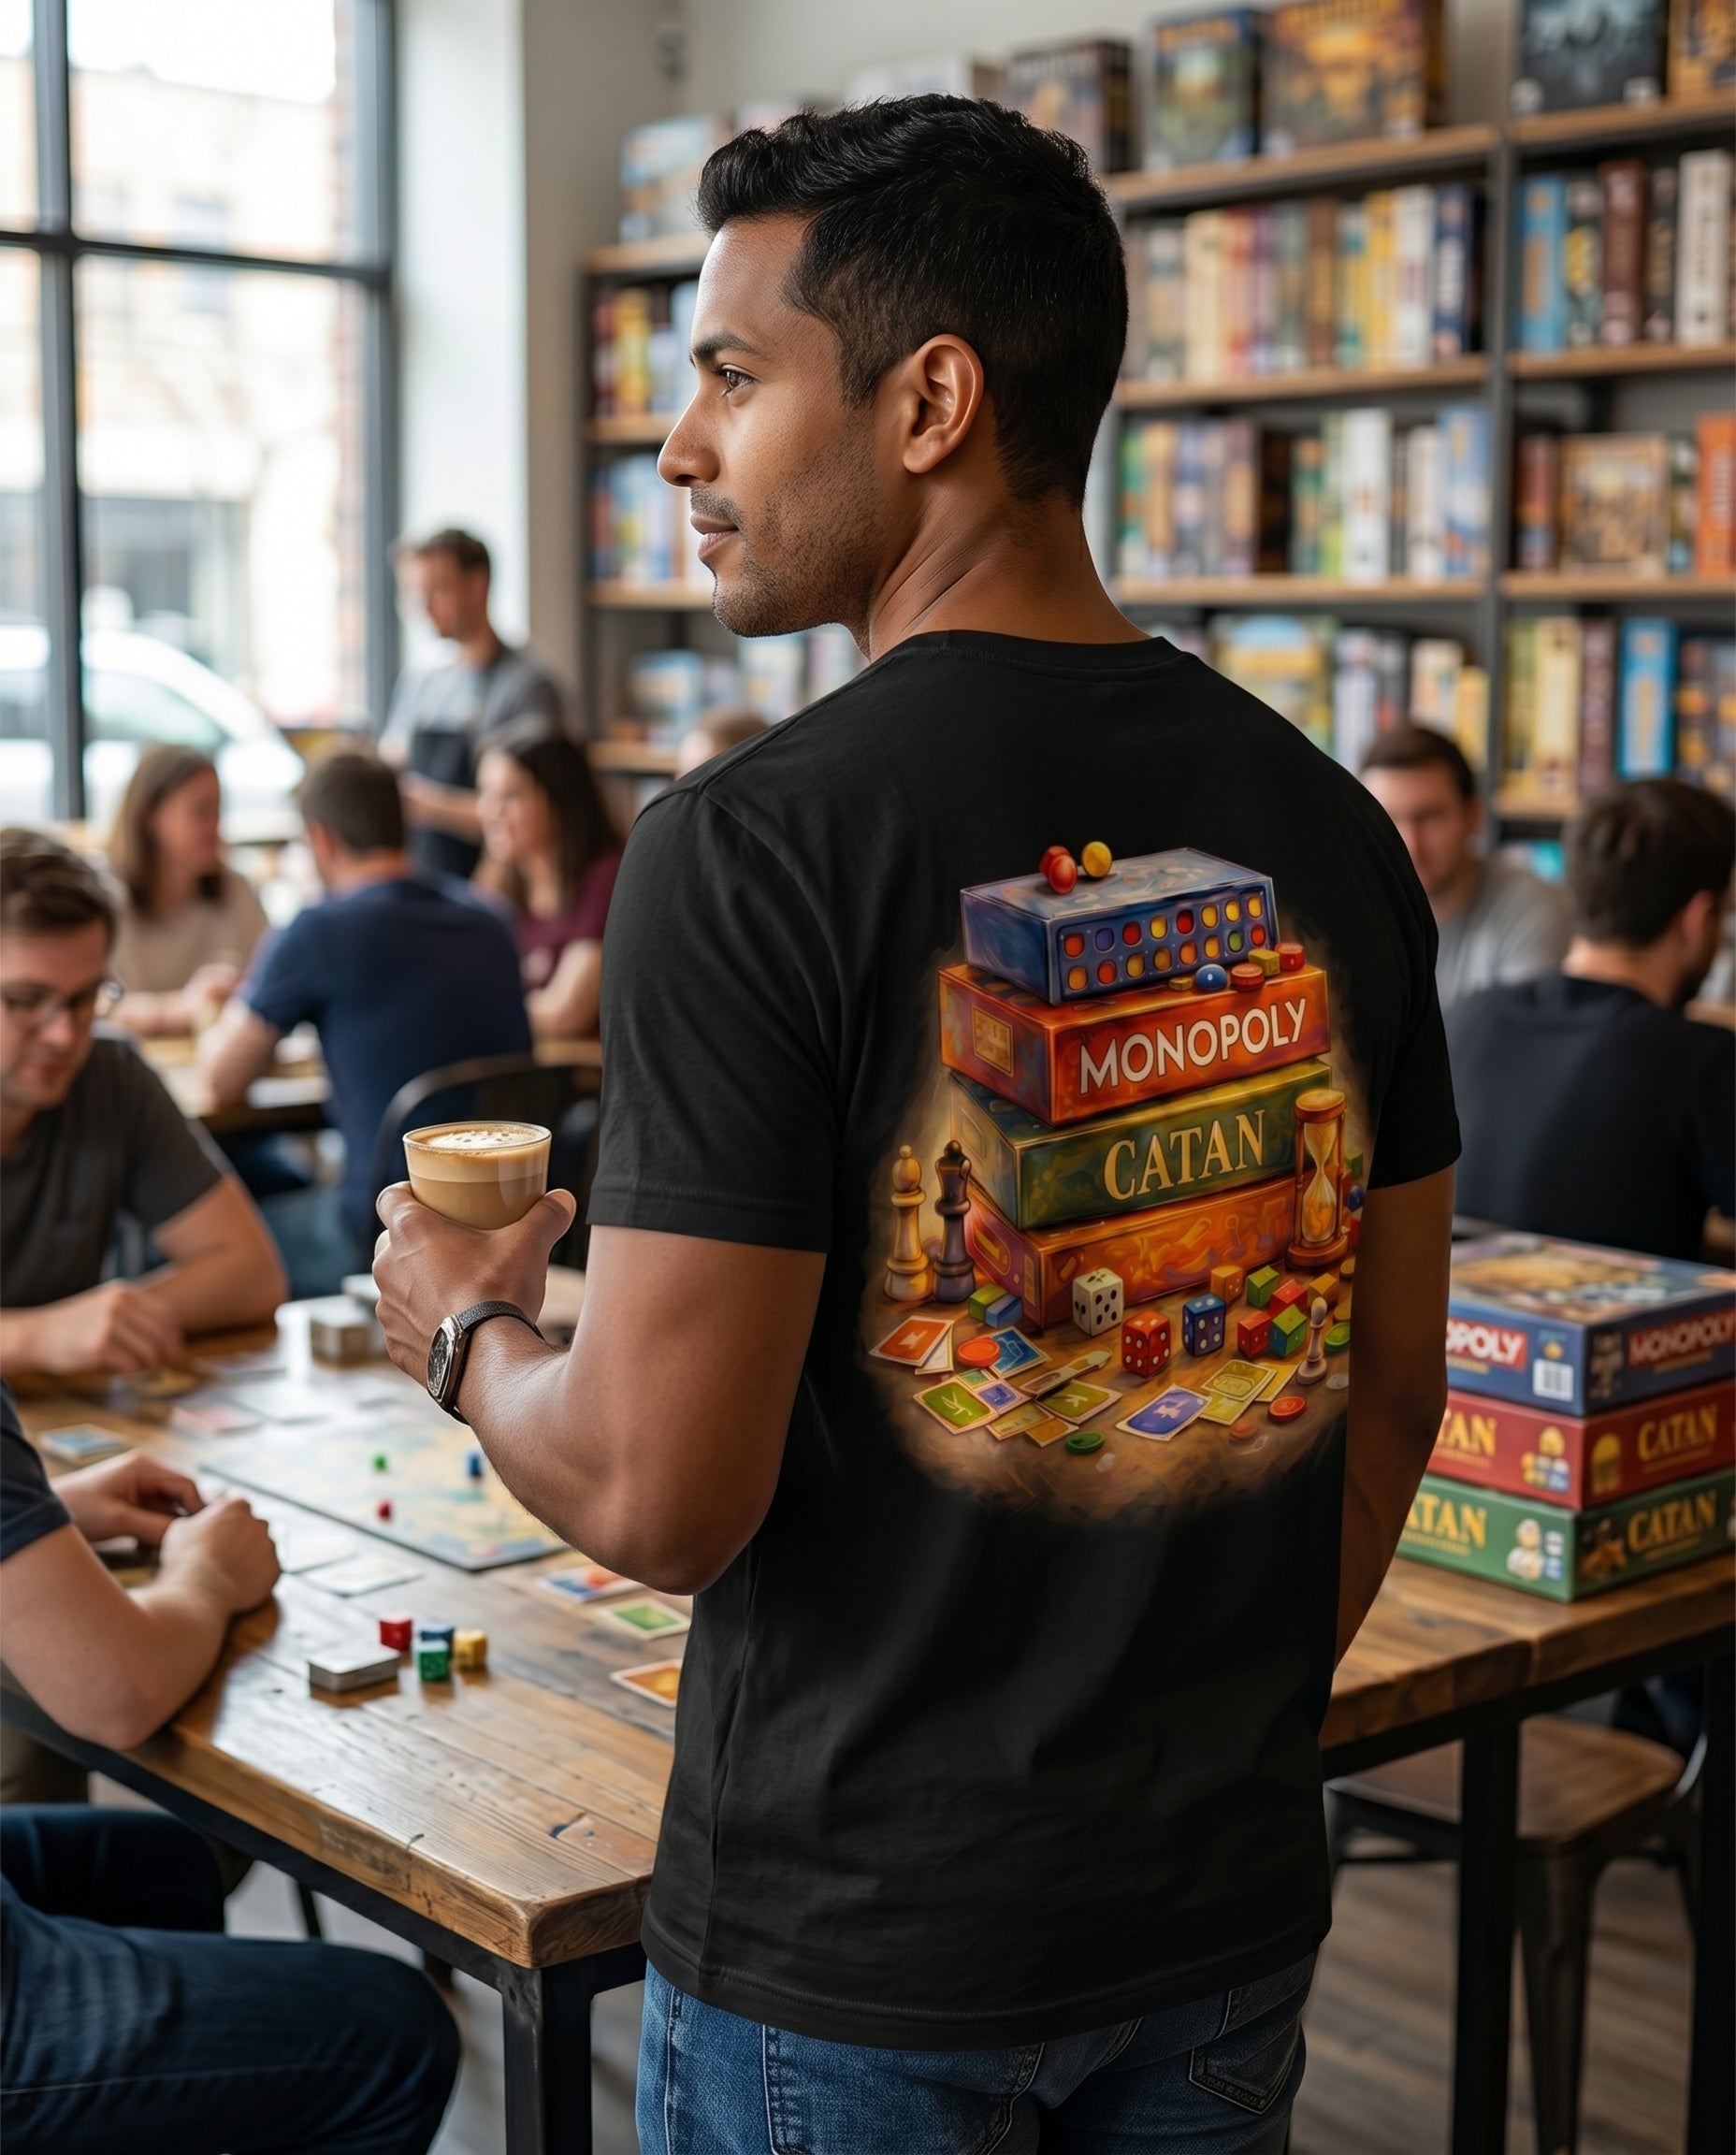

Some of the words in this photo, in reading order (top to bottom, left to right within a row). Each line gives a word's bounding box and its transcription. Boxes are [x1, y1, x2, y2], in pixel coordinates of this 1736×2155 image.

[1079, 998, 1307, 1095] MONOPOLY
[1104, 1109, 1266, 1201] CATAN
[1628, 1310, 1736, 1365] MONOPOLY
[1638, 1405, 1718, 1461] CATAN
[1628, 1489, 1717, 1553] CATAN
